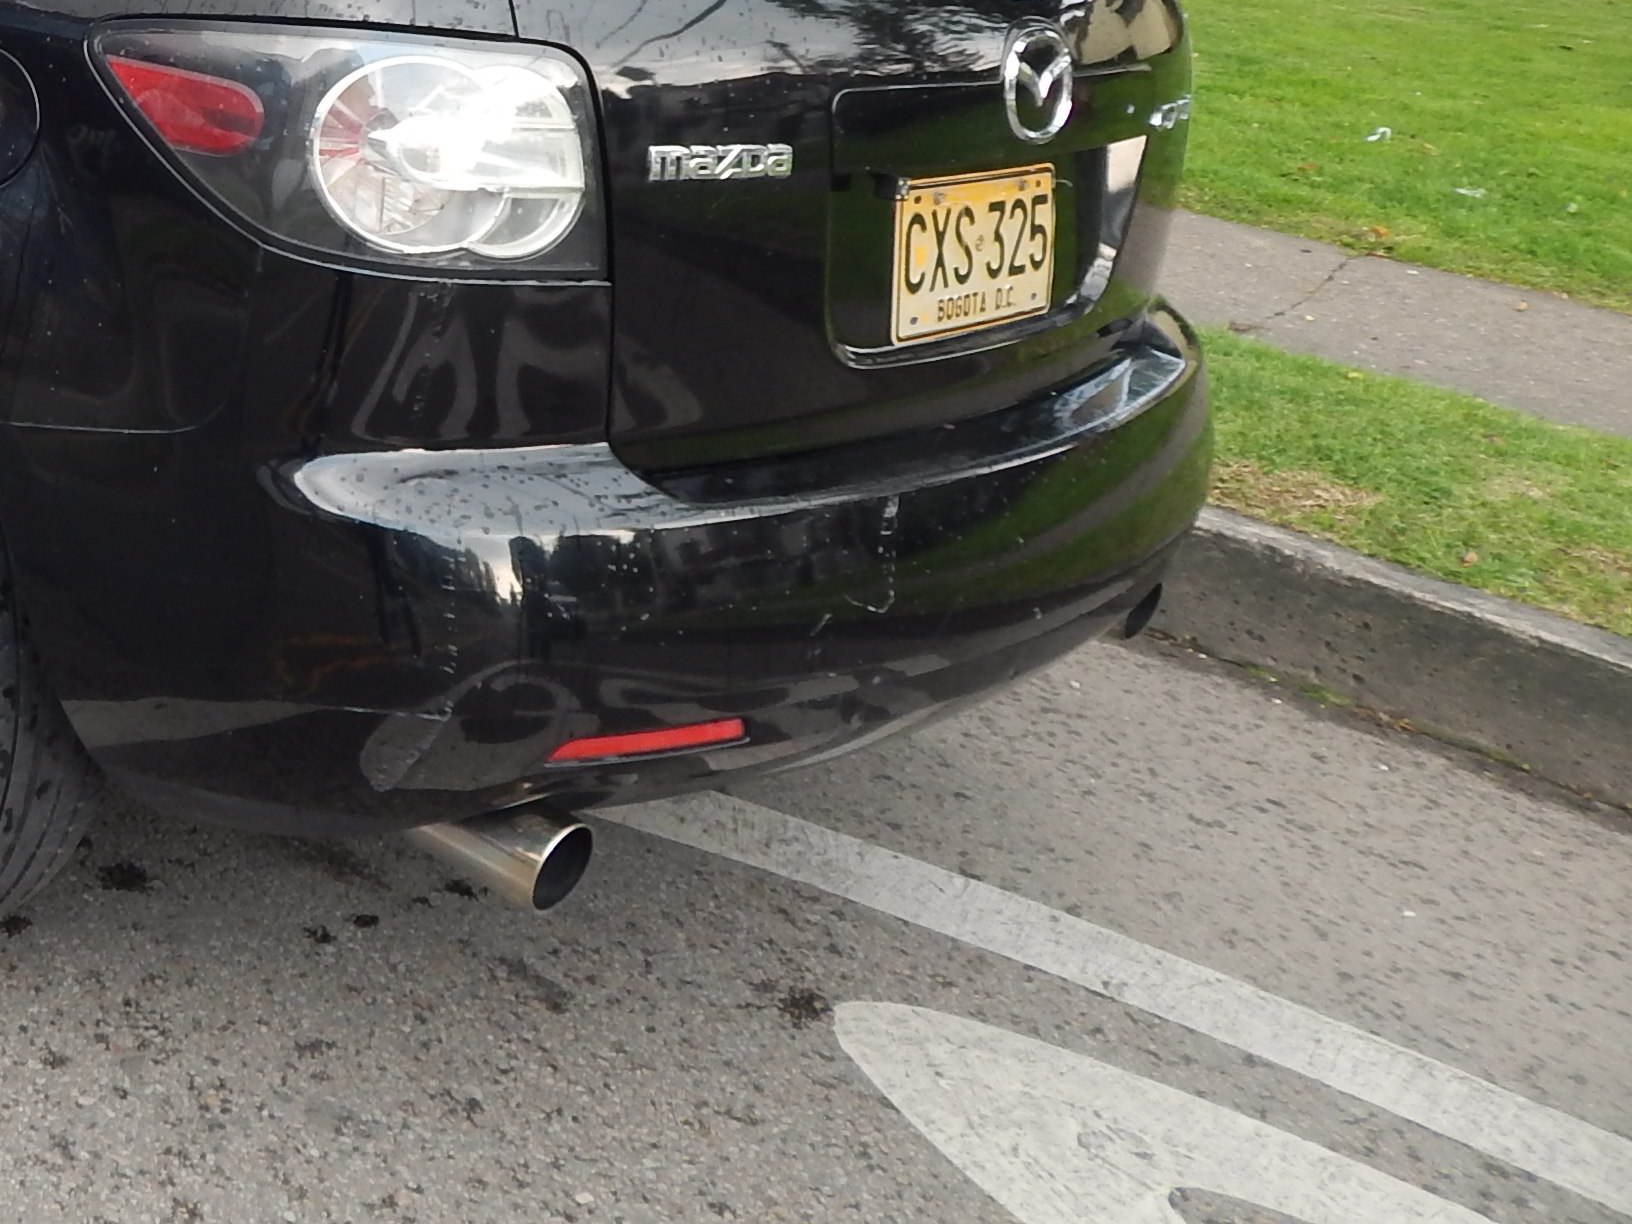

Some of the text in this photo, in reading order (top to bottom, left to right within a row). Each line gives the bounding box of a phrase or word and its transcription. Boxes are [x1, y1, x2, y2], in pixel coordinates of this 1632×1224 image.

[904, 194, 1050, 294] CXS 325
[937, 291, 986, 323] BOGOTA
